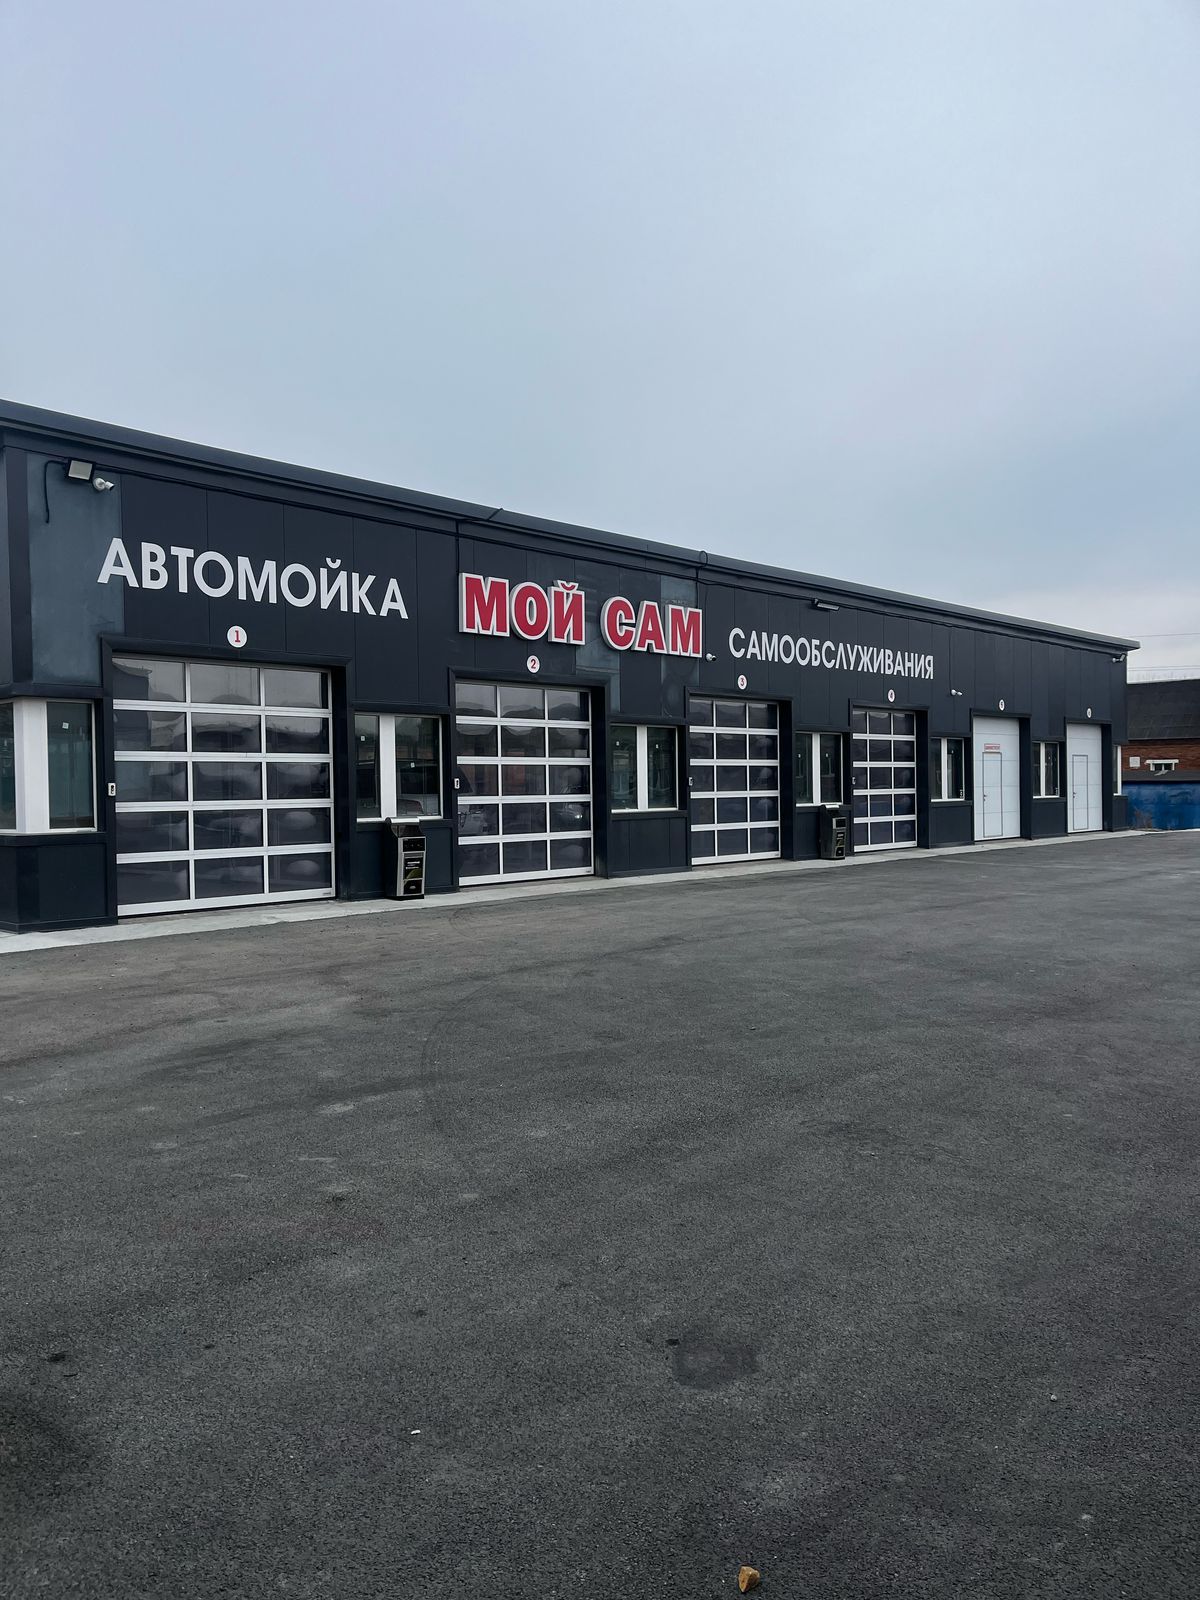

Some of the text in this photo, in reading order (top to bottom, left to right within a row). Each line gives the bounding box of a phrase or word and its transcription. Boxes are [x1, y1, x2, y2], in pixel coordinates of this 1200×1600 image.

[97, 537, 409, 620] АВТОМОЙКА
[234, 630, 241, 643] 1
[459, 572, 703, 658] МОЙ САМ
[530, 658, 537, 669] 2
[728, 627, 934, 680] САМООБСЛУЖИВАНИЯ
